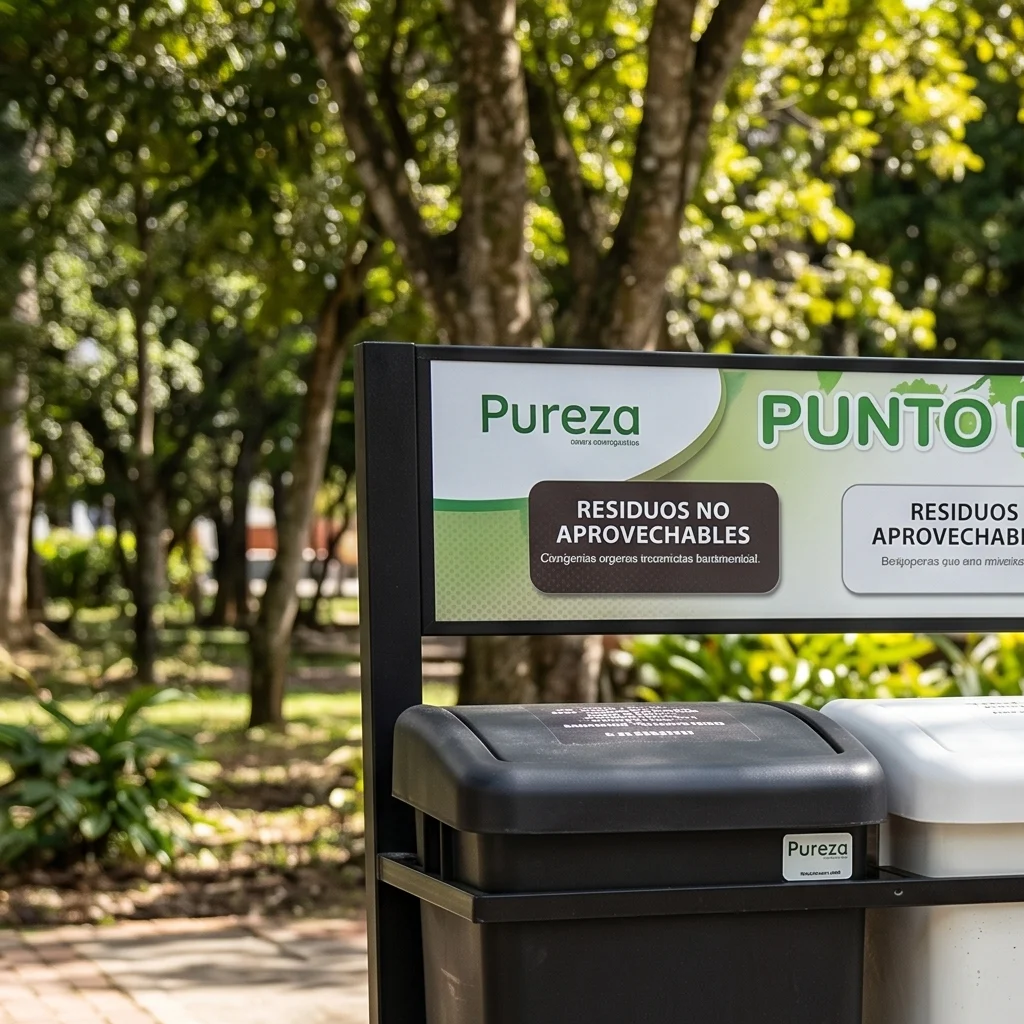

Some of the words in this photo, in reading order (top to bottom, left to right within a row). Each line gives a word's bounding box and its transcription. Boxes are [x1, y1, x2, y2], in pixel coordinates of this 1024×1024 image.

[481, 394, 639, 435] Pureza
[760, 391, 994, 450] PUNTO
[577, 500, 690, 520] RESIDUOS
[696, 501, 730, 520] NO
[911, 502, 1019, 521] RESIDUOS
[556, 525, 750, 544] APROVECHABLES
[788, 841, 848, 856] Pureza
